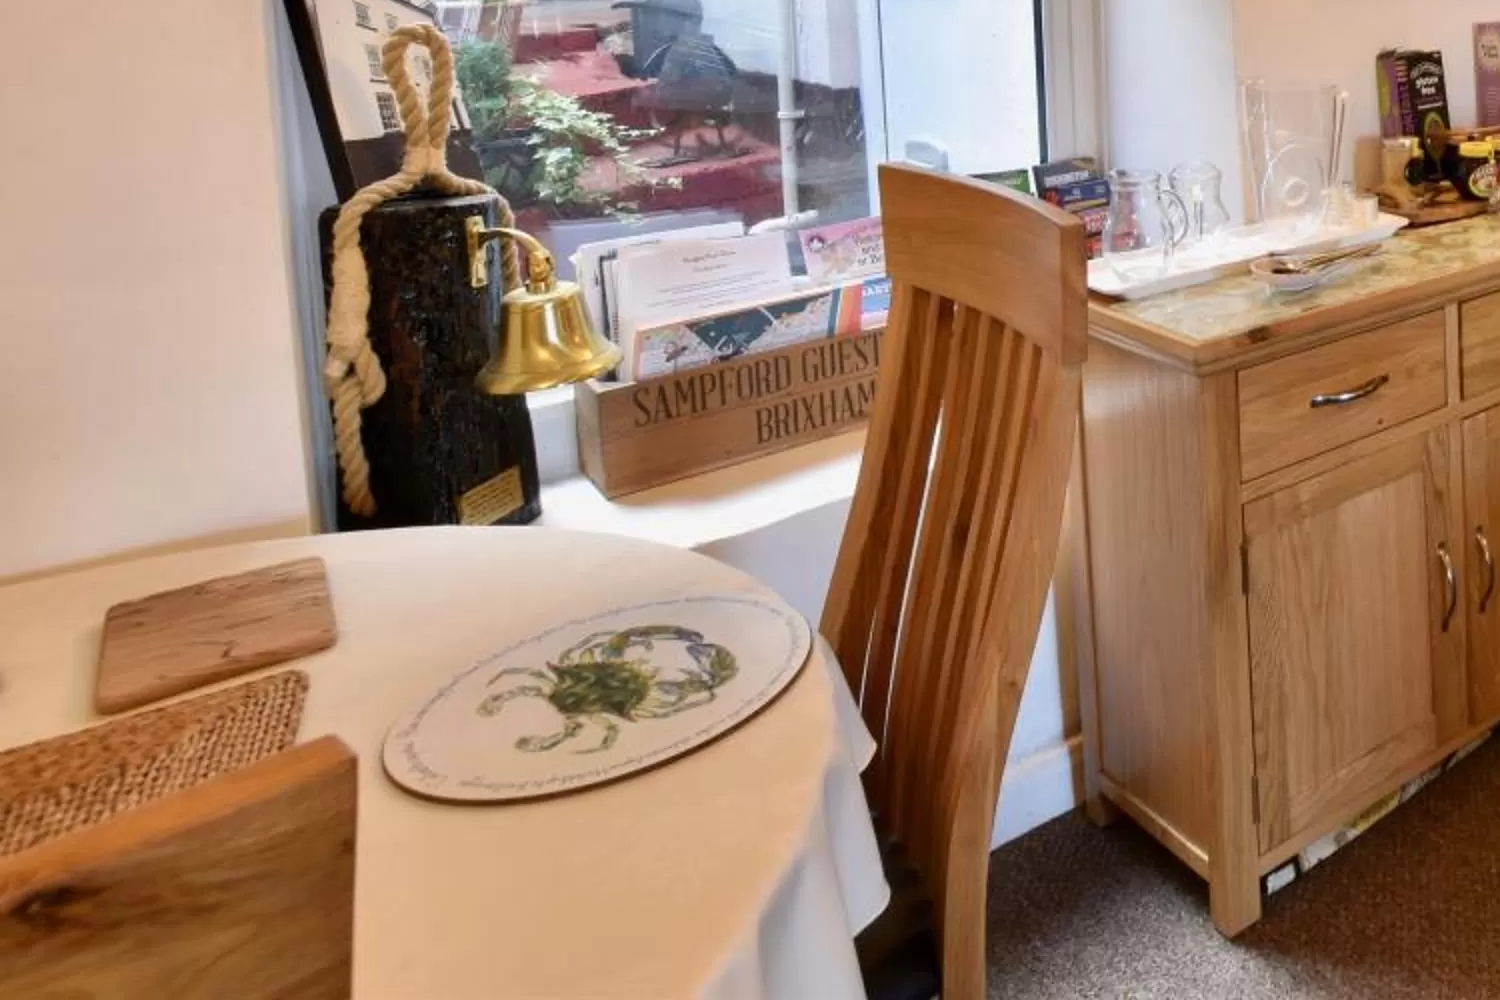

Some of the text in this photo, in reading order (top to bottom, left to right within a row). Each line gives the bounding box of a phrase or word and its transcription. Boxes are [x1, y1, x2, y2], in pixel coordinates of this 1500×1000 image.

[633, 331, 884, 429] SAMPFORD GUEST
[756, 379, 876, 445] BRIXHAM
